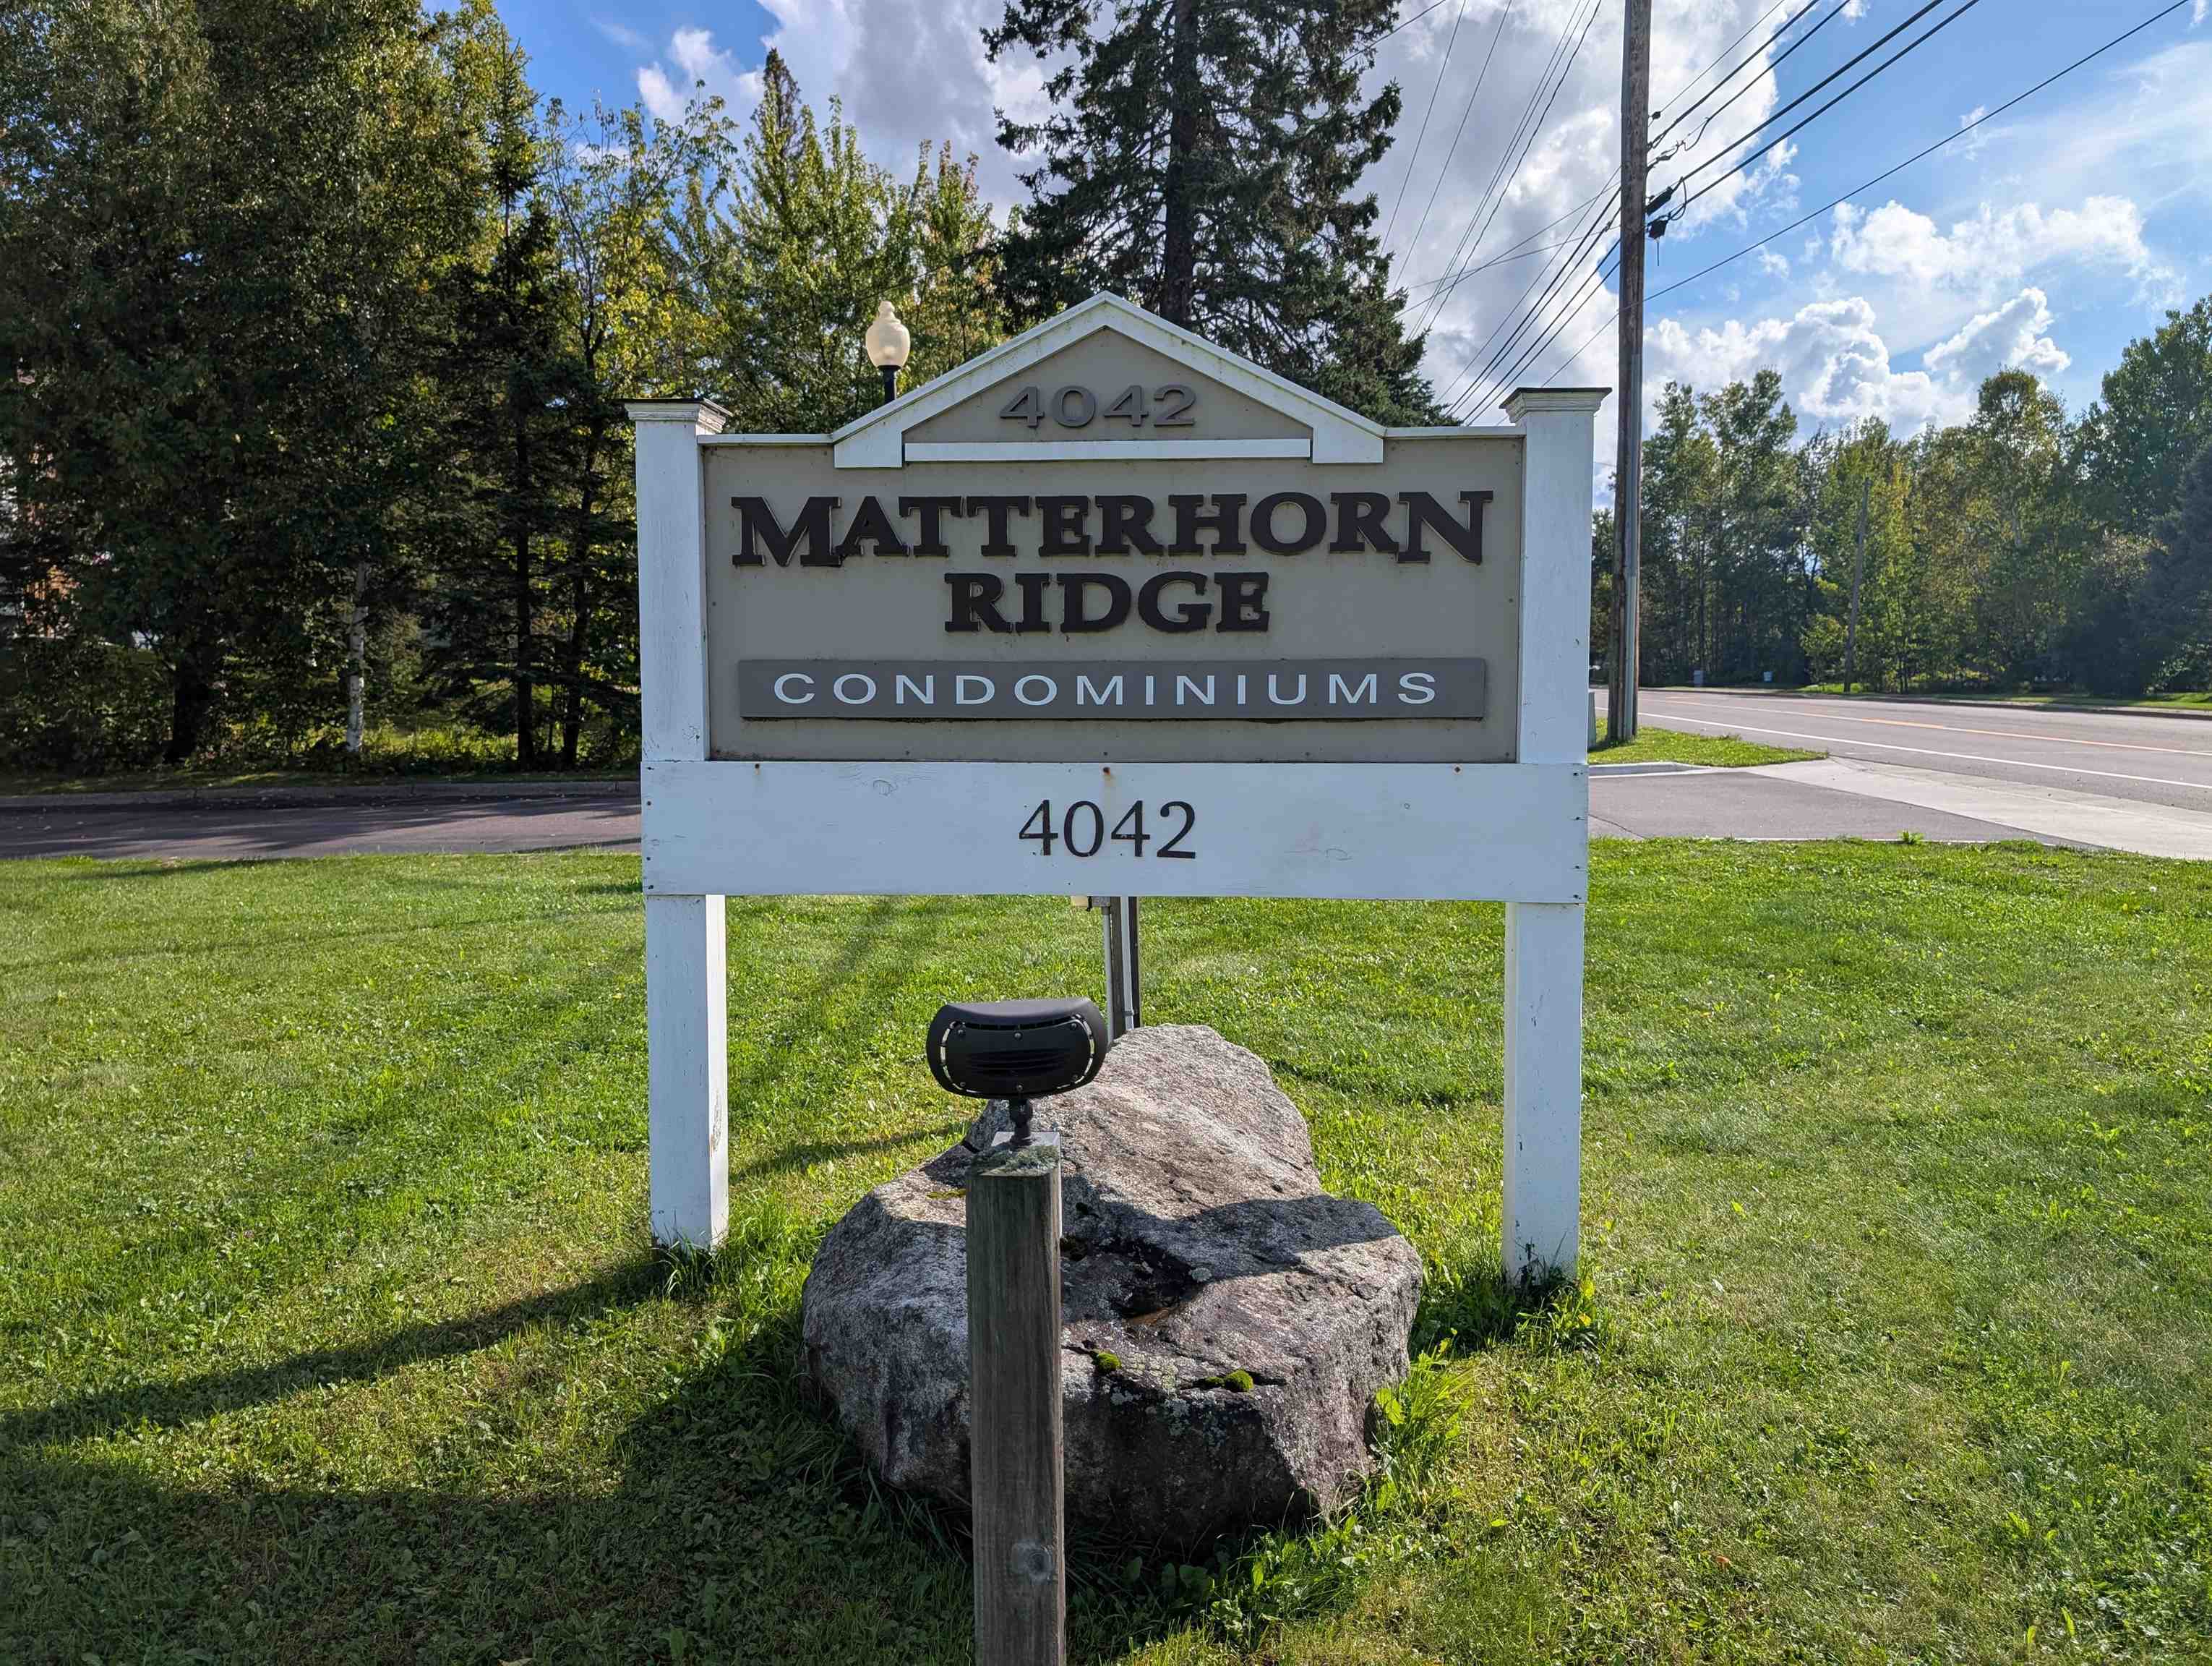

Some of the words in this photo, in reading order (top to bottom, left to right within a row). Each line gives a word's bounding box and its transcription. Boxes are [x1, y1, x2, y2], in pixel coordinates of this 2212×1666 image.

[1000, 384, 1196, 428] 4042
[731, 490, 1493, 568] MATTERHORN
[944, 571, 1271, 633] RIDGE
[773, 672, 1439, 706] CONDOMINIUMS
[1019, 800, 1197, 860] 4042
